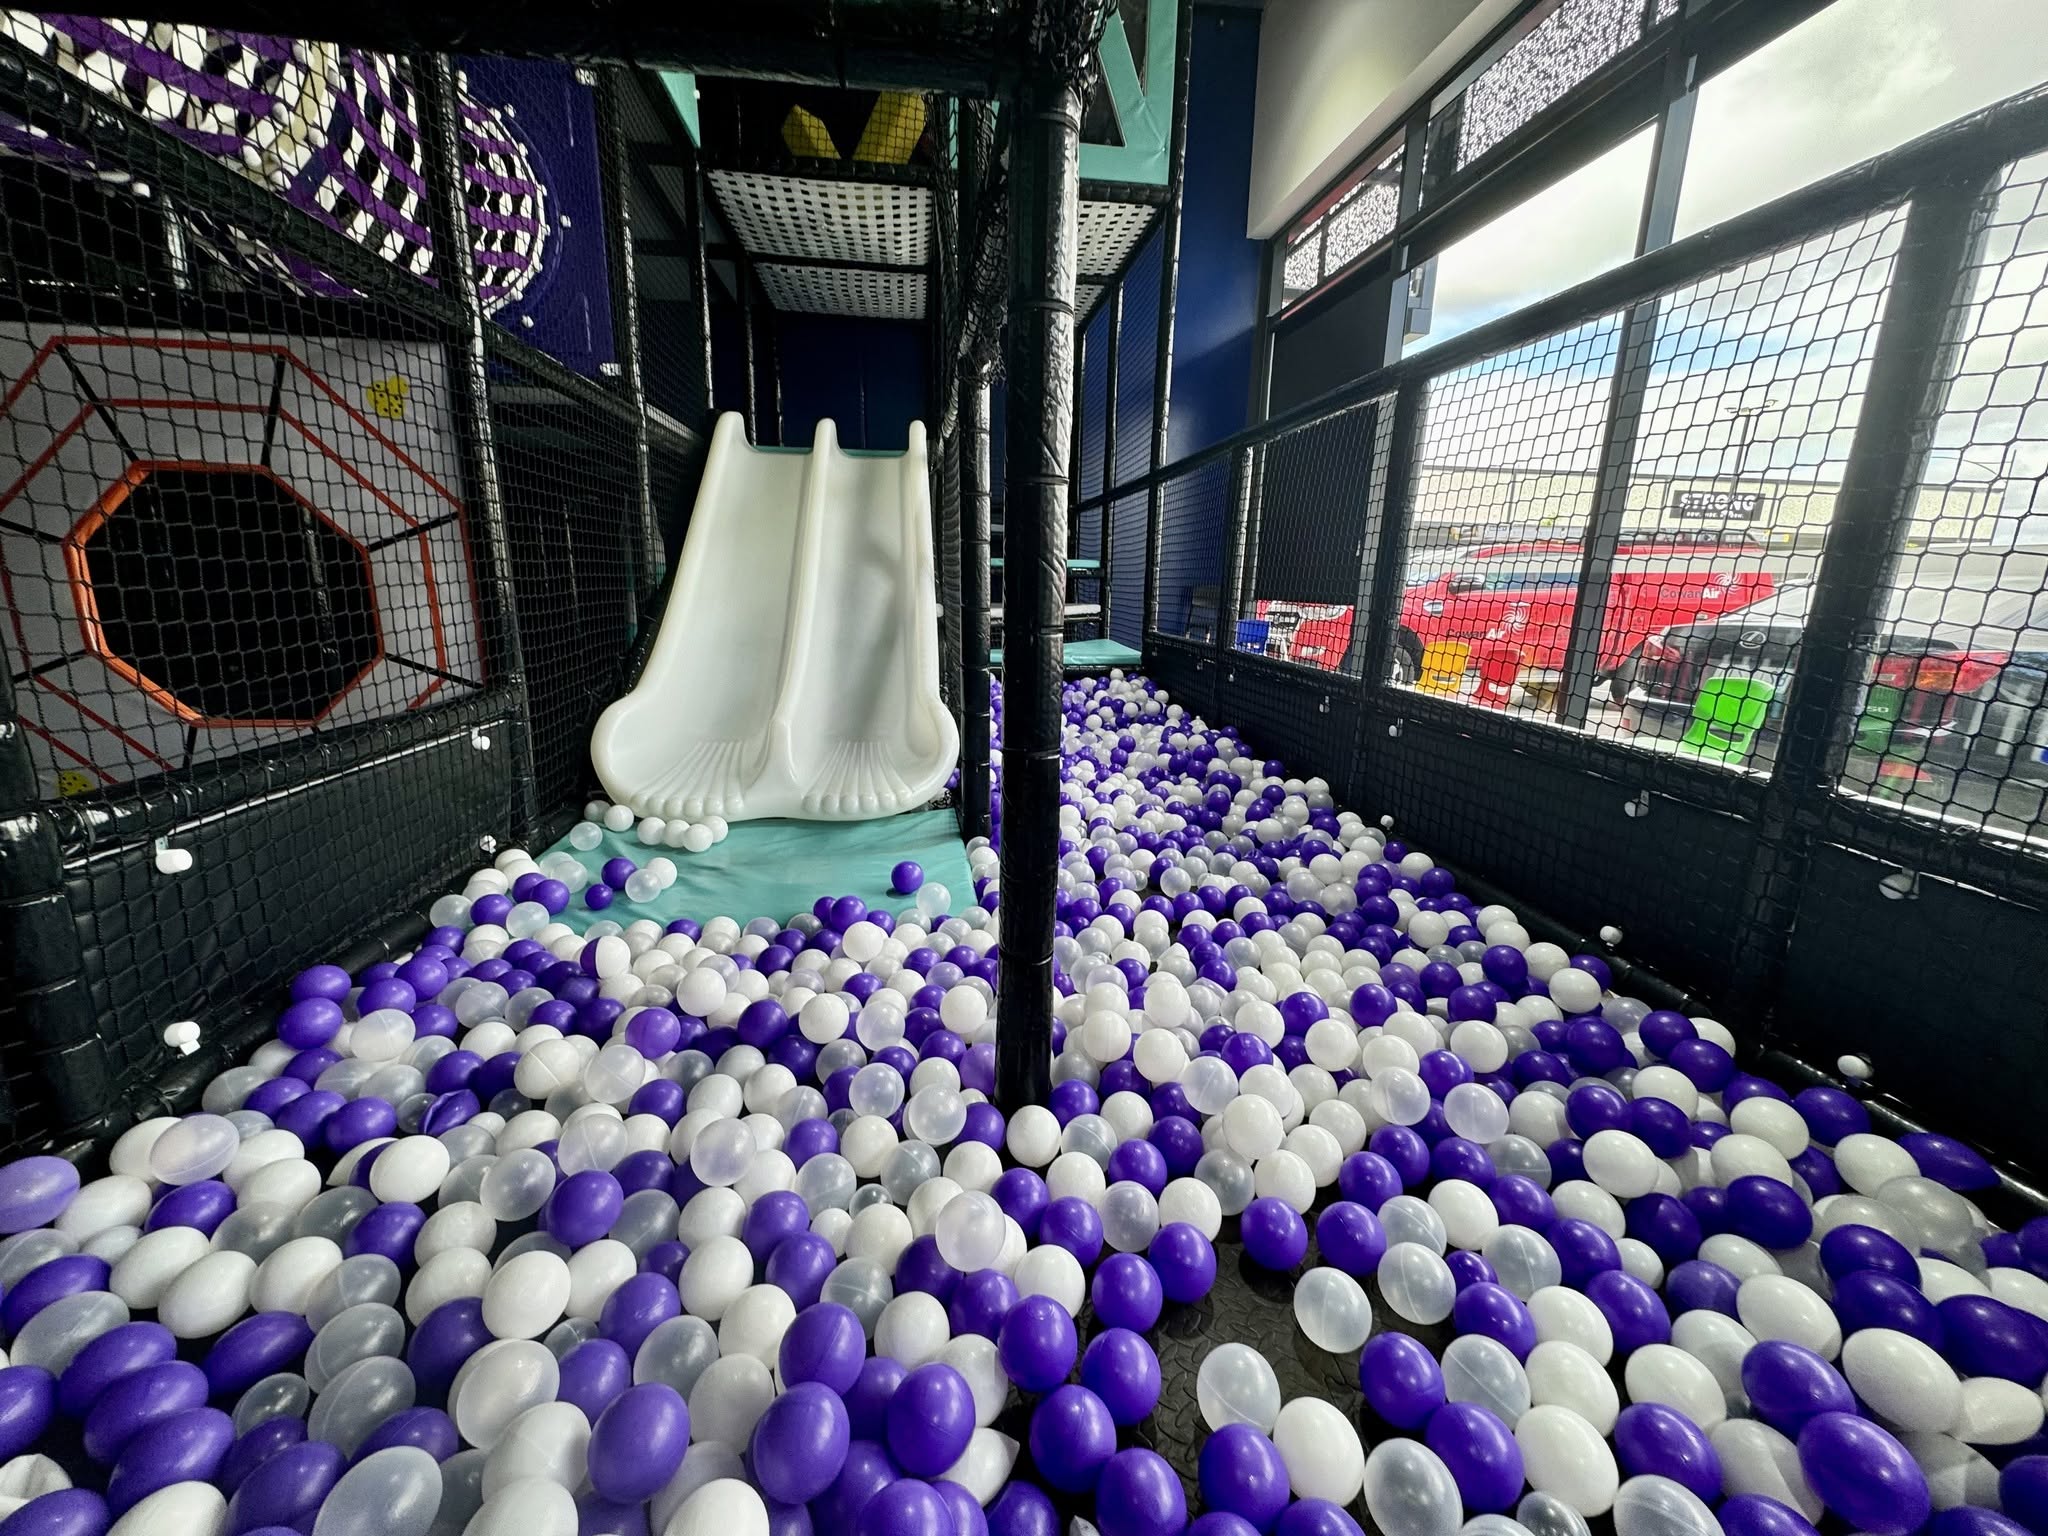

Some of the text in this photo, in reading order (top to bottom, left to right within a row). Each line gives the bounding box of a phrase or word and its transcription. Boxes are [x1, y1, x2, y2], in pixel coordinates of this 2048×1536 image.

[1679, 493, 1756, 511] STRONG
[1661, 588, 1720, 599] CowanAir
[1446, 628, 1506, 640] CowanAir
